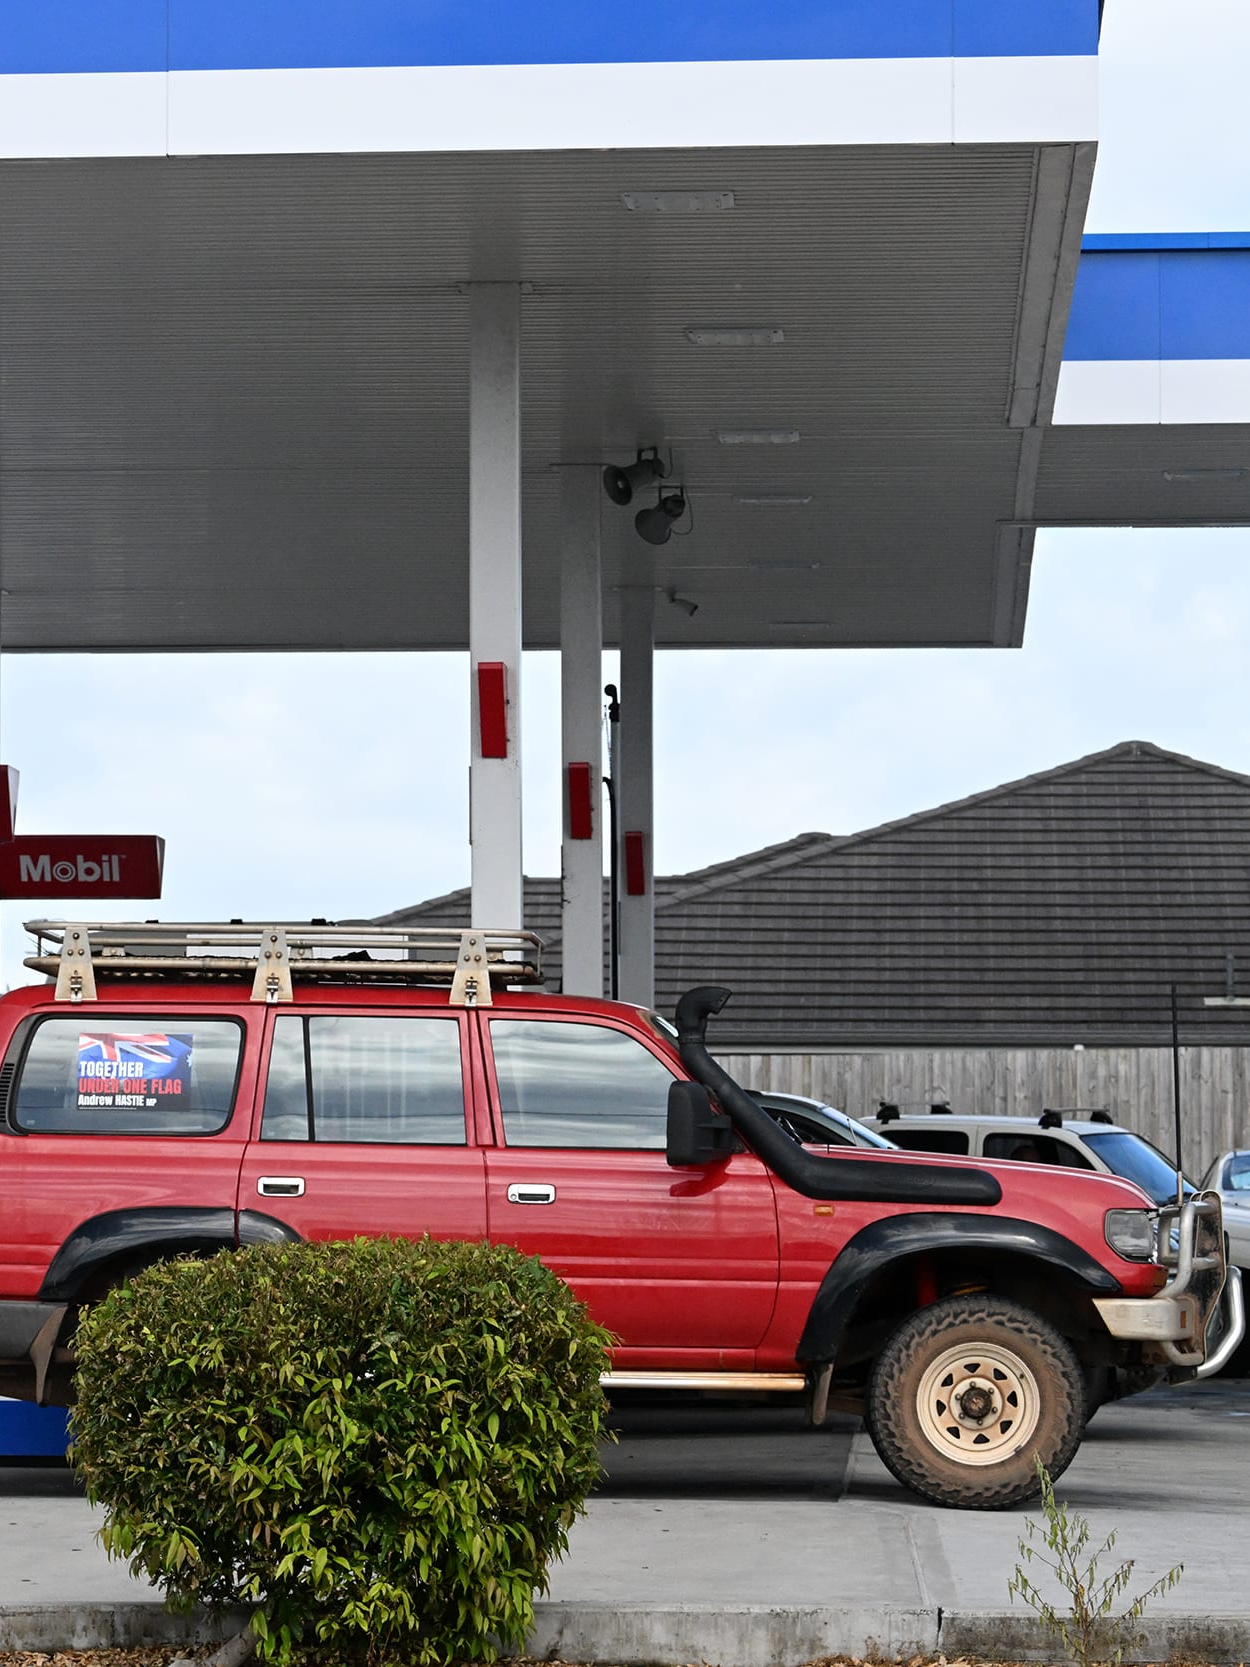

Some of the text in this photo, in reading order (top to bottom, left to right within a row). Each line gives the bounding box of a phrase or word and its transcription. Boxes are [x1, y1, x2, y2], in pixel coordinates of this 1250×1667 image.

[79, 1061, 144, 1078] TOGETHER
[78, 1078, 182, 1095] UNDER ONE FLAG
[78, 1094, 157, 1107] Andrew HASTIE MP
